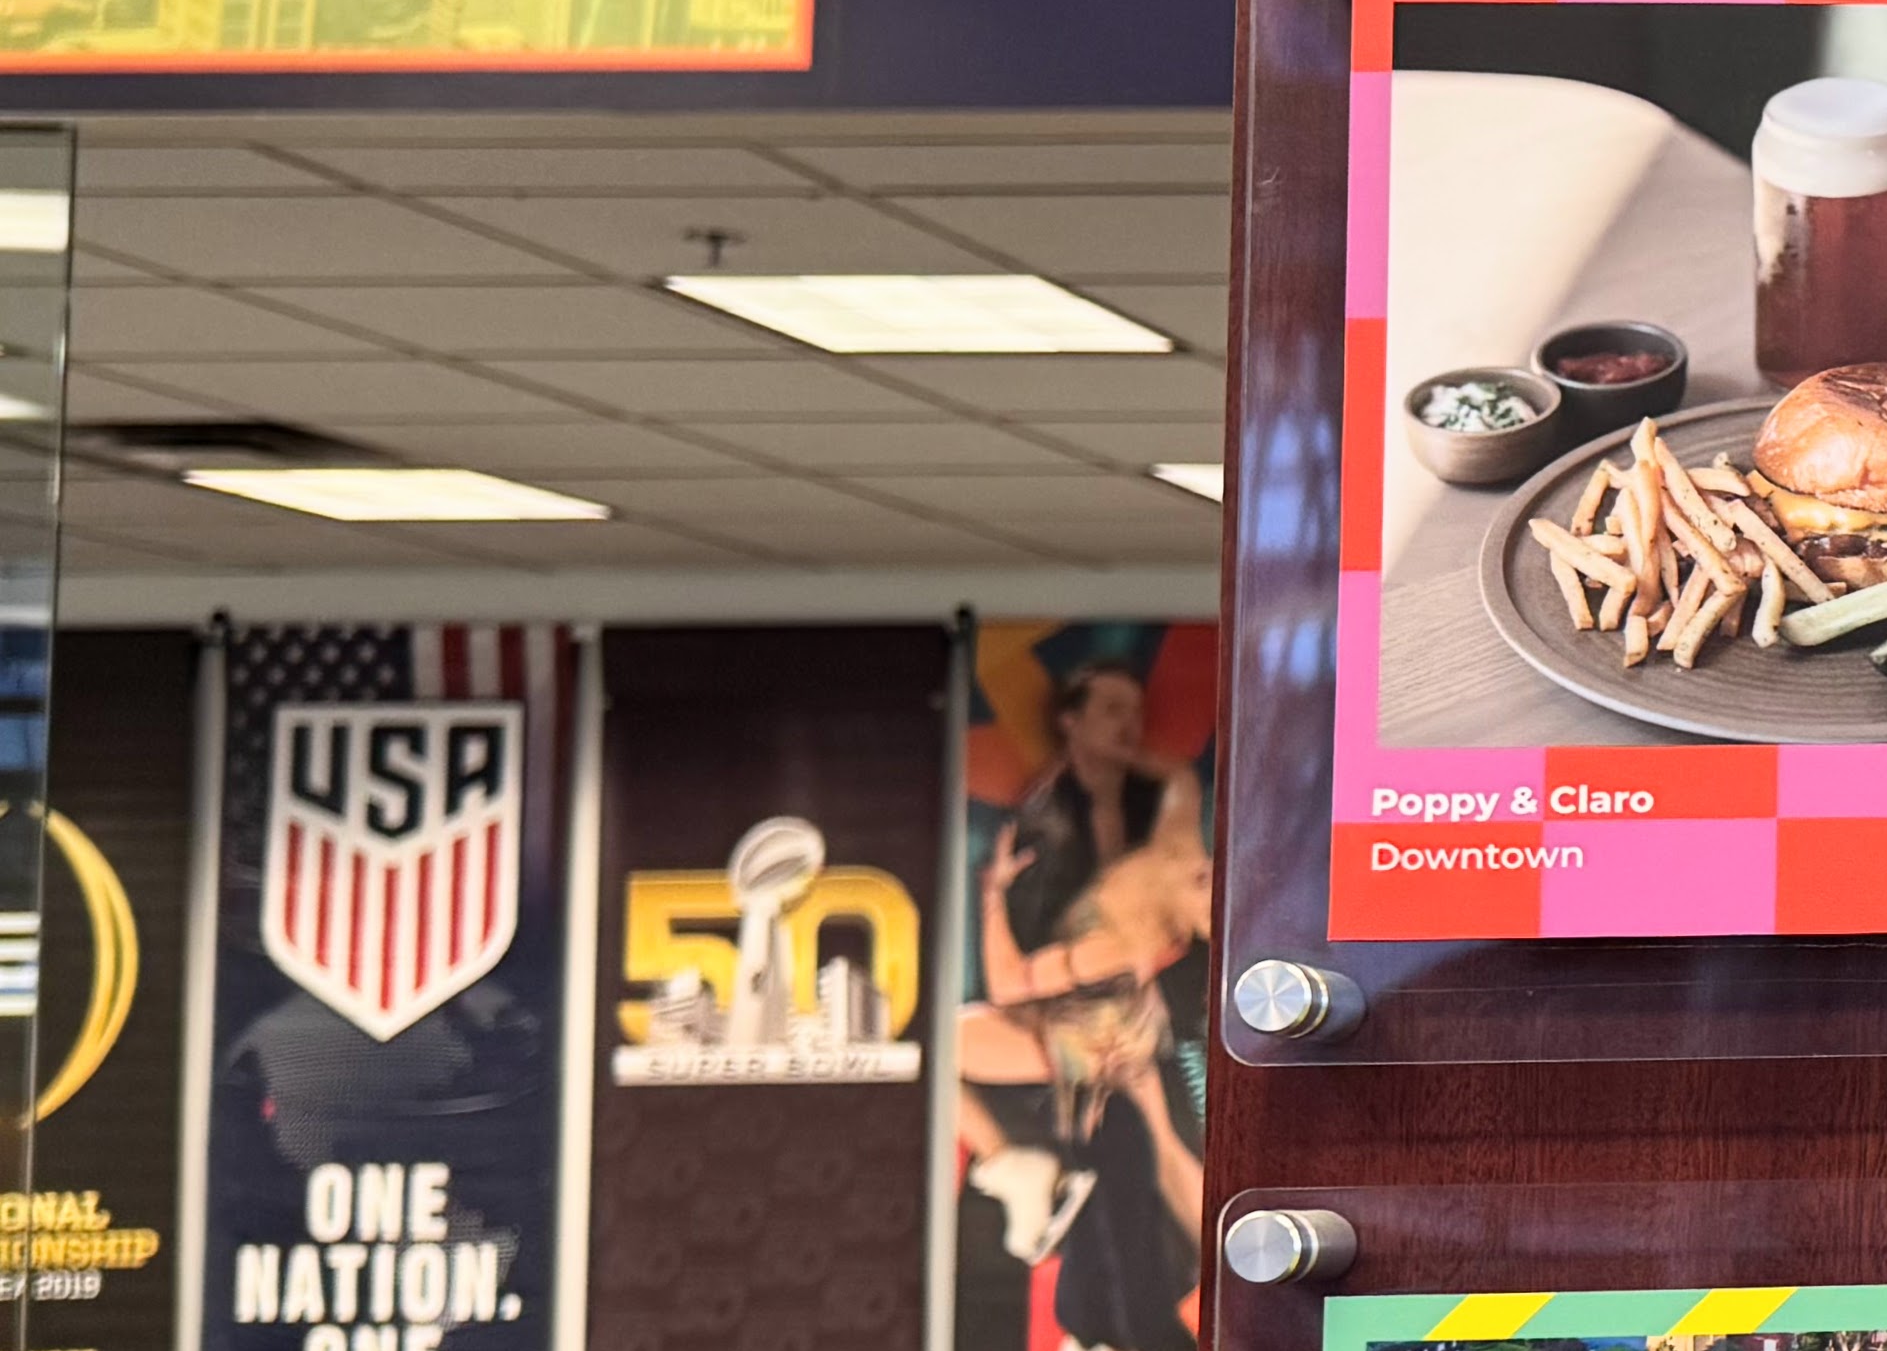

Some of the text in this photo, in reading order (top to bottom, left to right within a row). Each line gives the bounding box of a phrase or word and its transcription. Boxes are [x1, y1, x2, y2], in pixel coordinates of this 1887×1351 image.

[289, 723, 504, 837] USA
[1371, 784, 1655, 823] Poppy & Claro
[1371, 841, 1585, 872] Downtown
[647, 1054, 890, 1082] SUPER BOWL
[306, 1162, 450, 1242] ONE
[234, 1247, 522, 1323] NATION.
